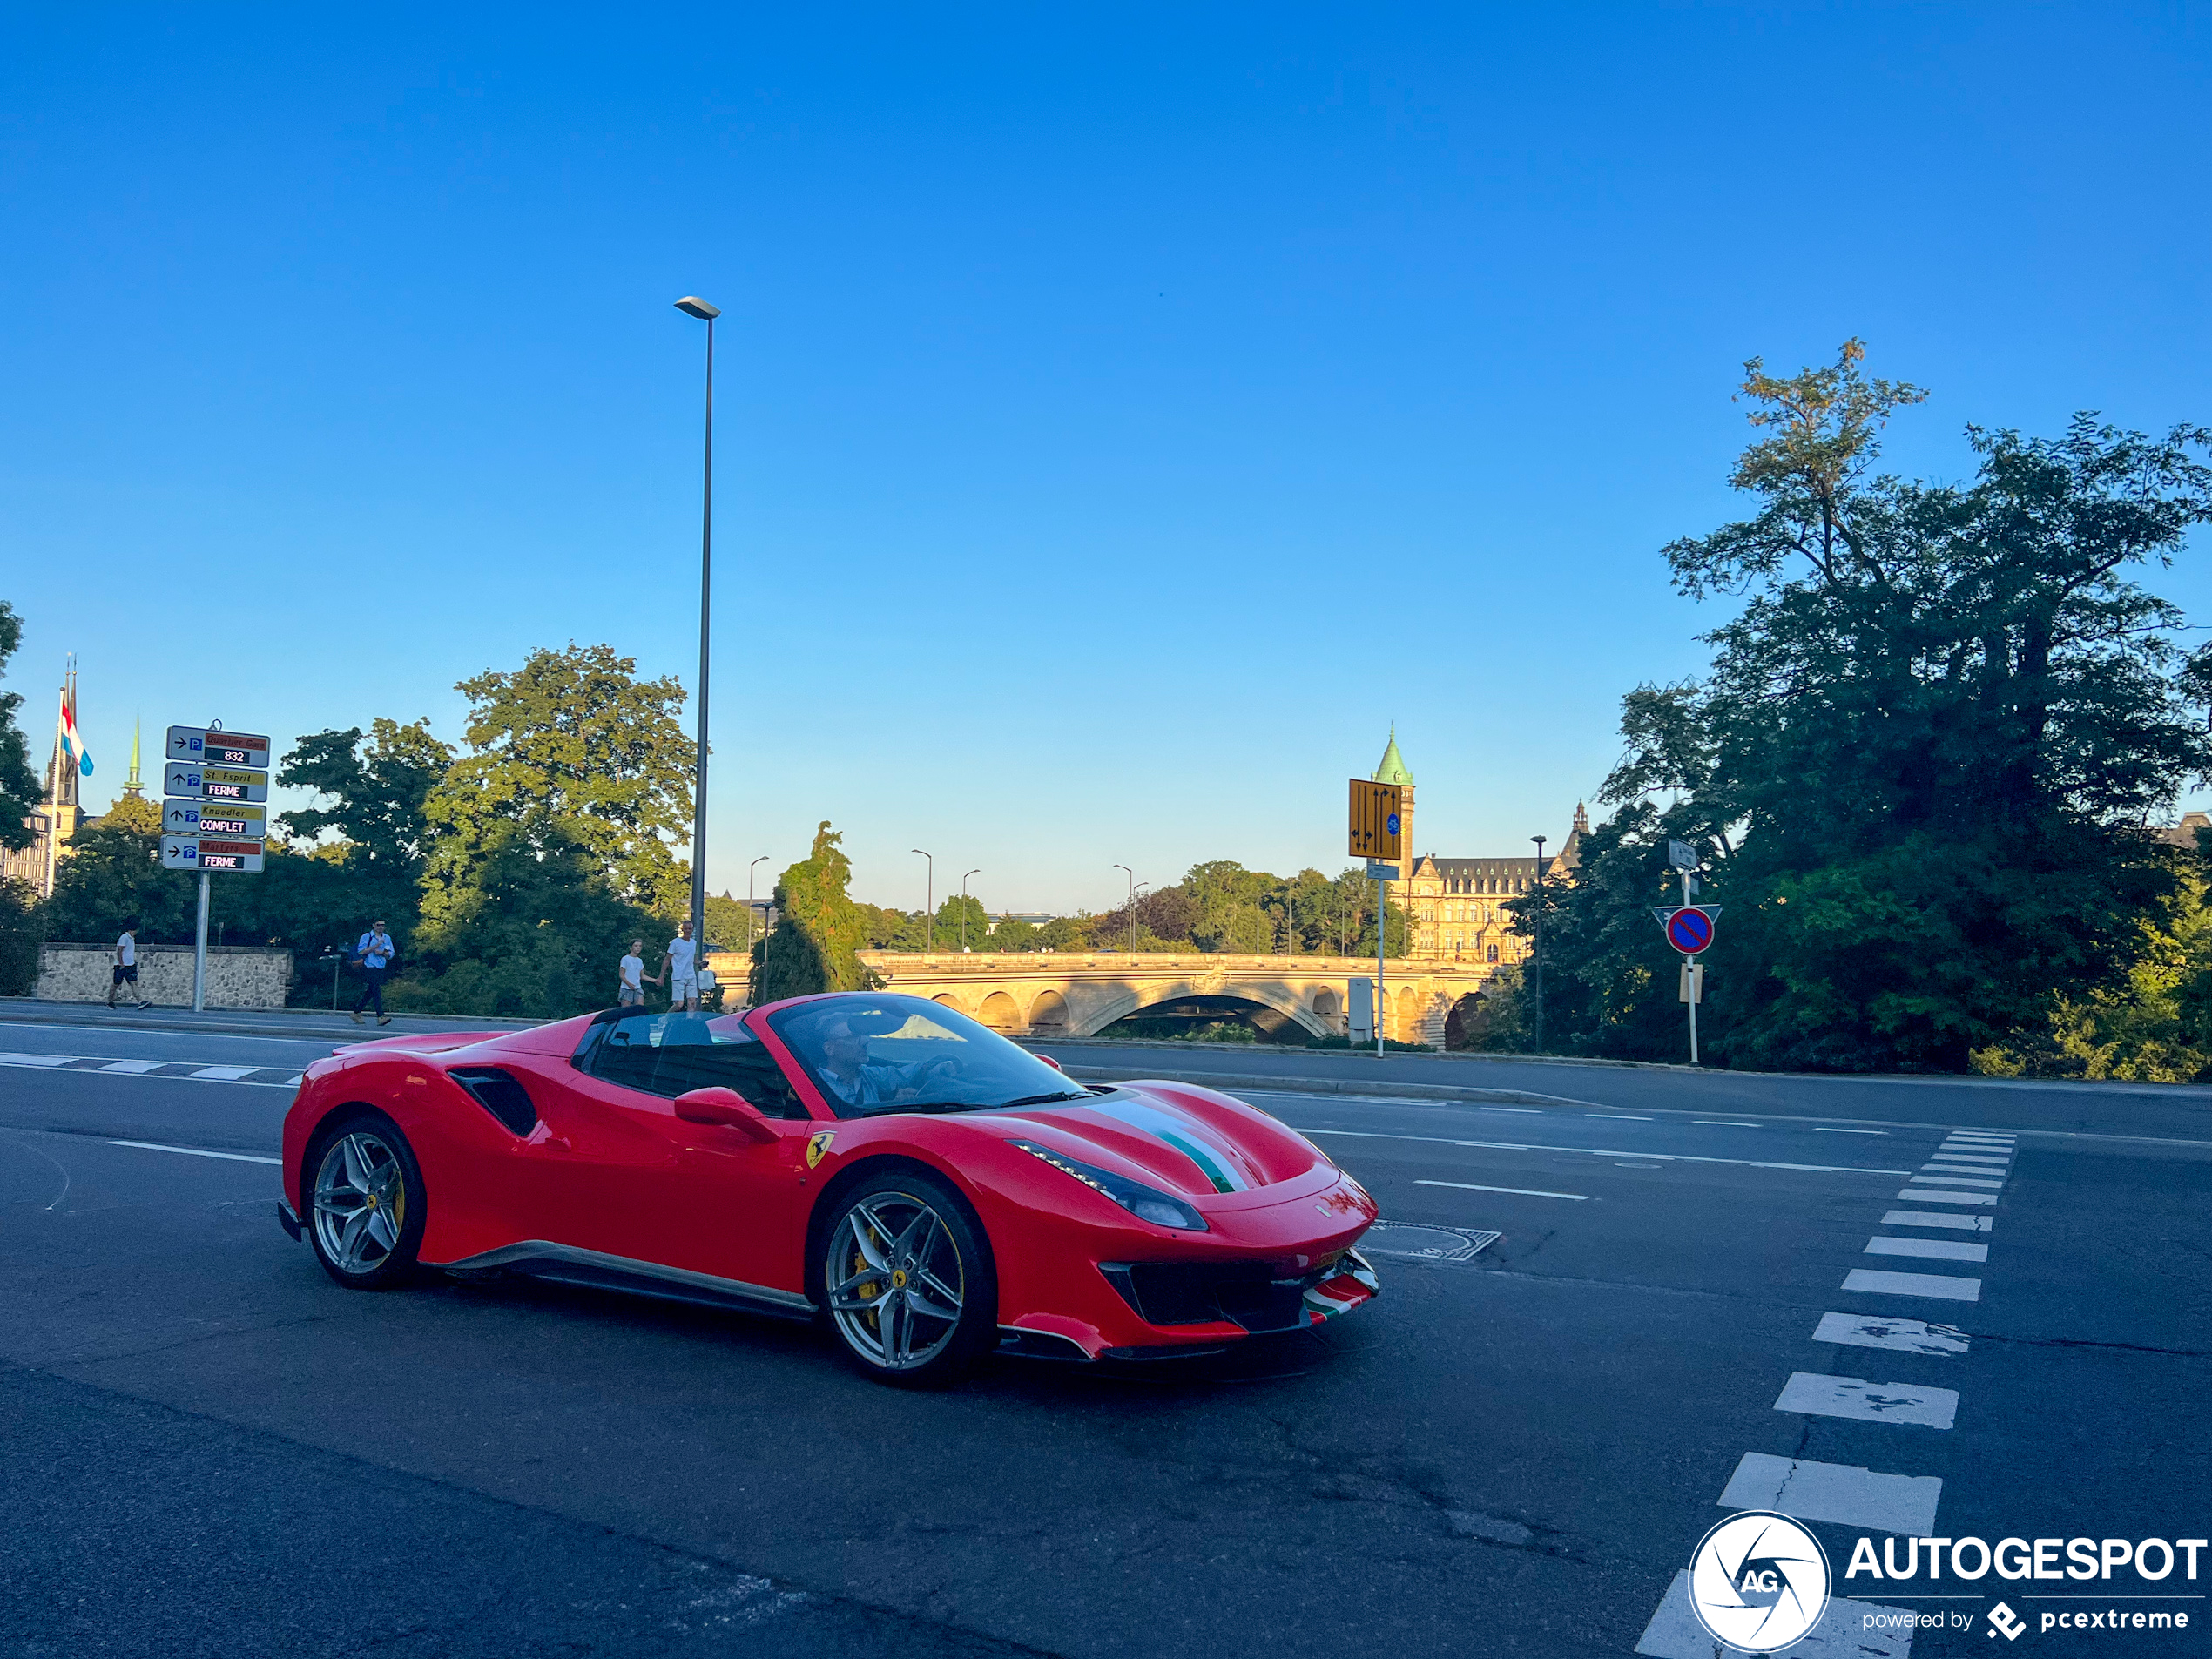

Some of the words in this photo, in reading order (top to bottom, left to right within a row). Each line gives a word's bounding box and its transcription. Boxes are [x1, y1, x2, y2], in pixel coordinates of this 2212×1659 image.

[246, 739, 265, 749] Gare
[224, 751, 245, 762] 832
[223, 772, 251, 782] Esprit
[208, 785, 240, 797] FERME
[202, 806, 246, 817] Knuedler
[199, 819, 245, 833] COMPLET
[201, 842, 239, 853] Martyrs
[204, 855, 237, 867] FERME
